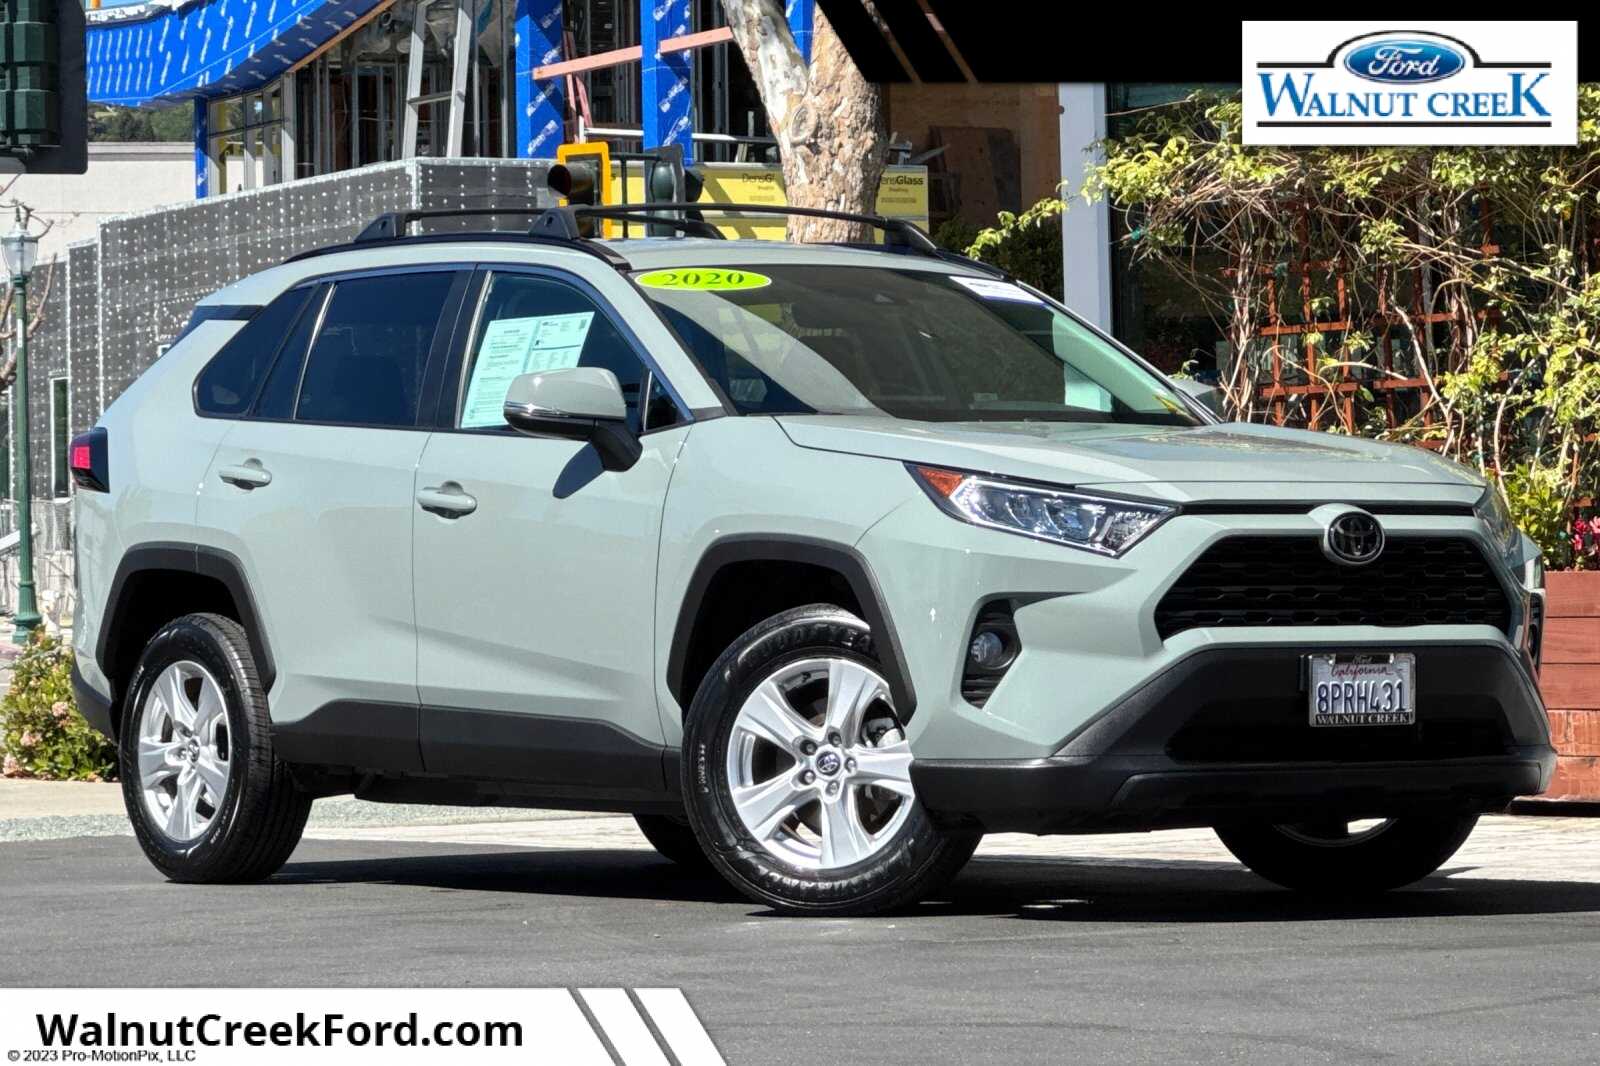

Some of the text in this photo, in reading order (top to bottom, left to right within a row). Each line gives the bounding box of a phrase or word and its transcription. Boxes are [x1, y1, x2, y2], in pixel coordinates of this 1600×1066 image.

[661, 272, 745, 286] 2020
[1317, 680, 1406, 713] 8PRH431
[1317, 713, 1408, 724] WALNUT CREEK
